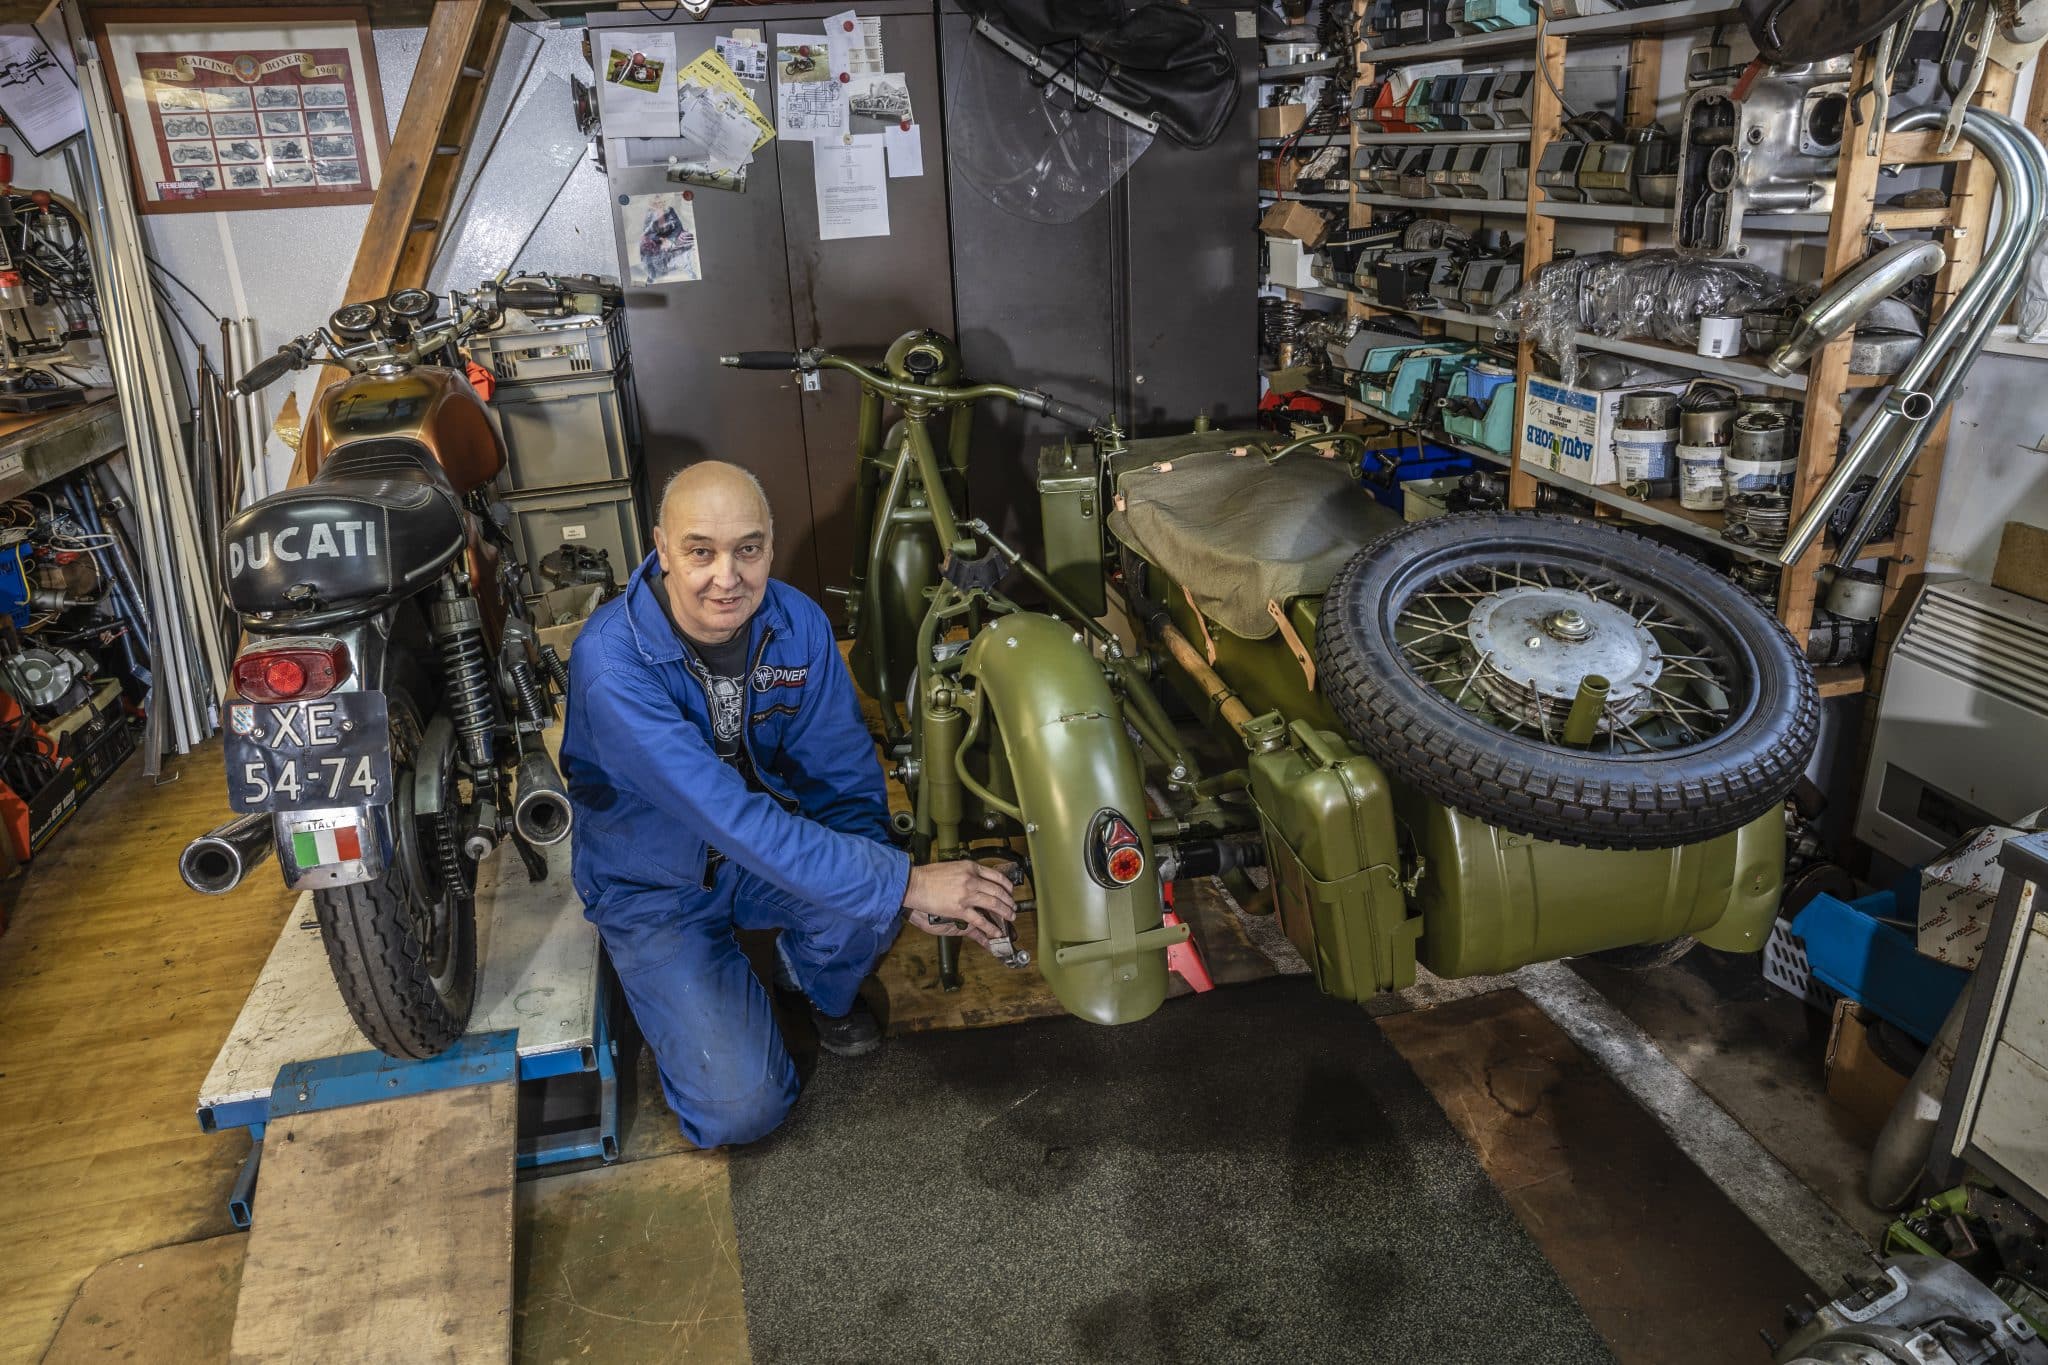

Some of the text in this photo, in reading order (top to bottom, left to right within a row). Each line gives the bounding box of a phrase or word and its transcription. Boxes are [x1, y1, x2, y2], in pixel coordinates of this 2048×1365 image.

[180, 53, 308, 74] RAICING BOXERS
[229, 520, 377, 579] DUCATI
[270, 703, 338, 748] XE
[244, 755, 377, 804] 54-74
[307, 819, 337, 832] ITALY
